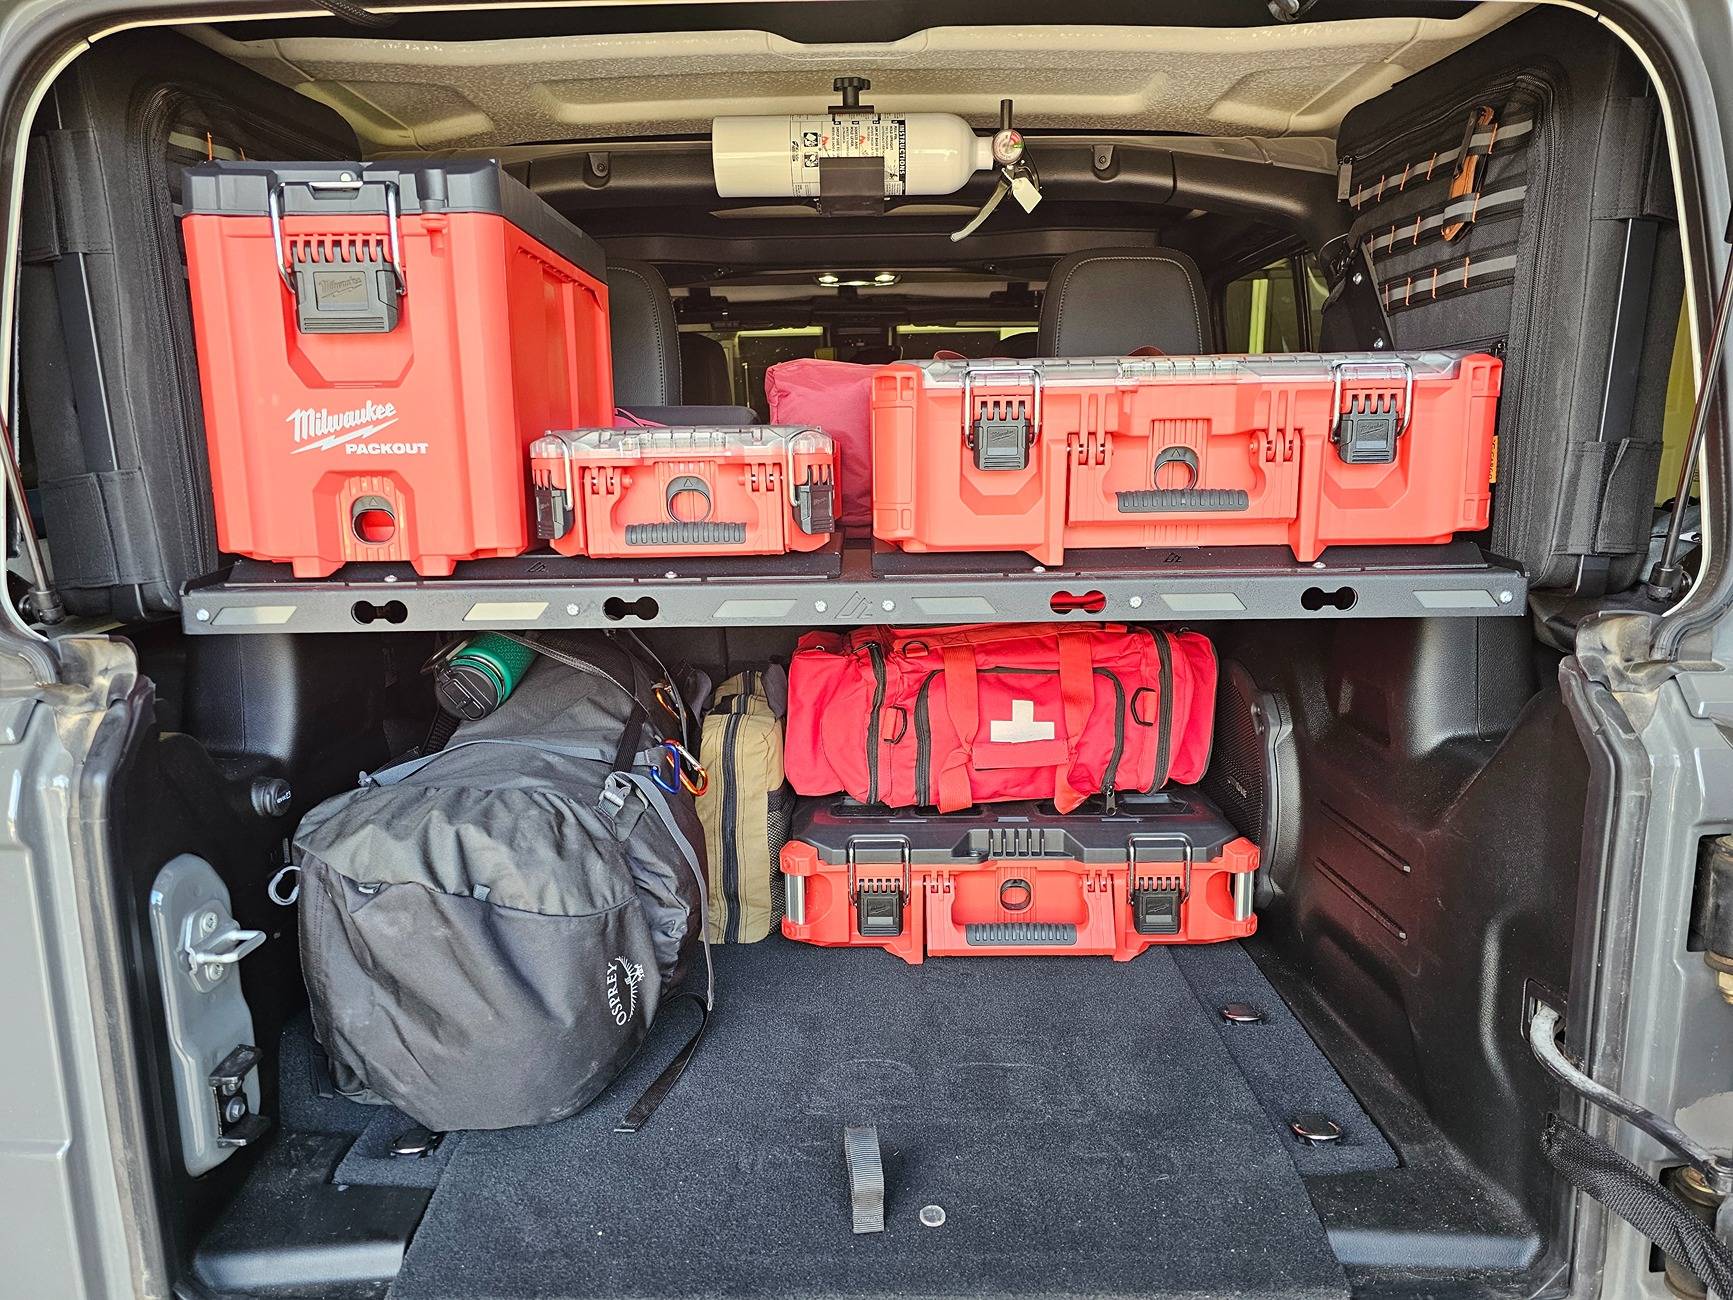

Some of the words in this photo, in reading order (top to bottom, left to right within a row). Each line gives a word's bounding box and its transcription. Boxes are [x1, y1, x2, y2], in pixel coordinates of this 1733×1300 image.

[285, 400, 398, 444] Milwaukee
[345, 442, 430, 456] PACKOUT
[606, 962, 627, 1025] OSPREY
